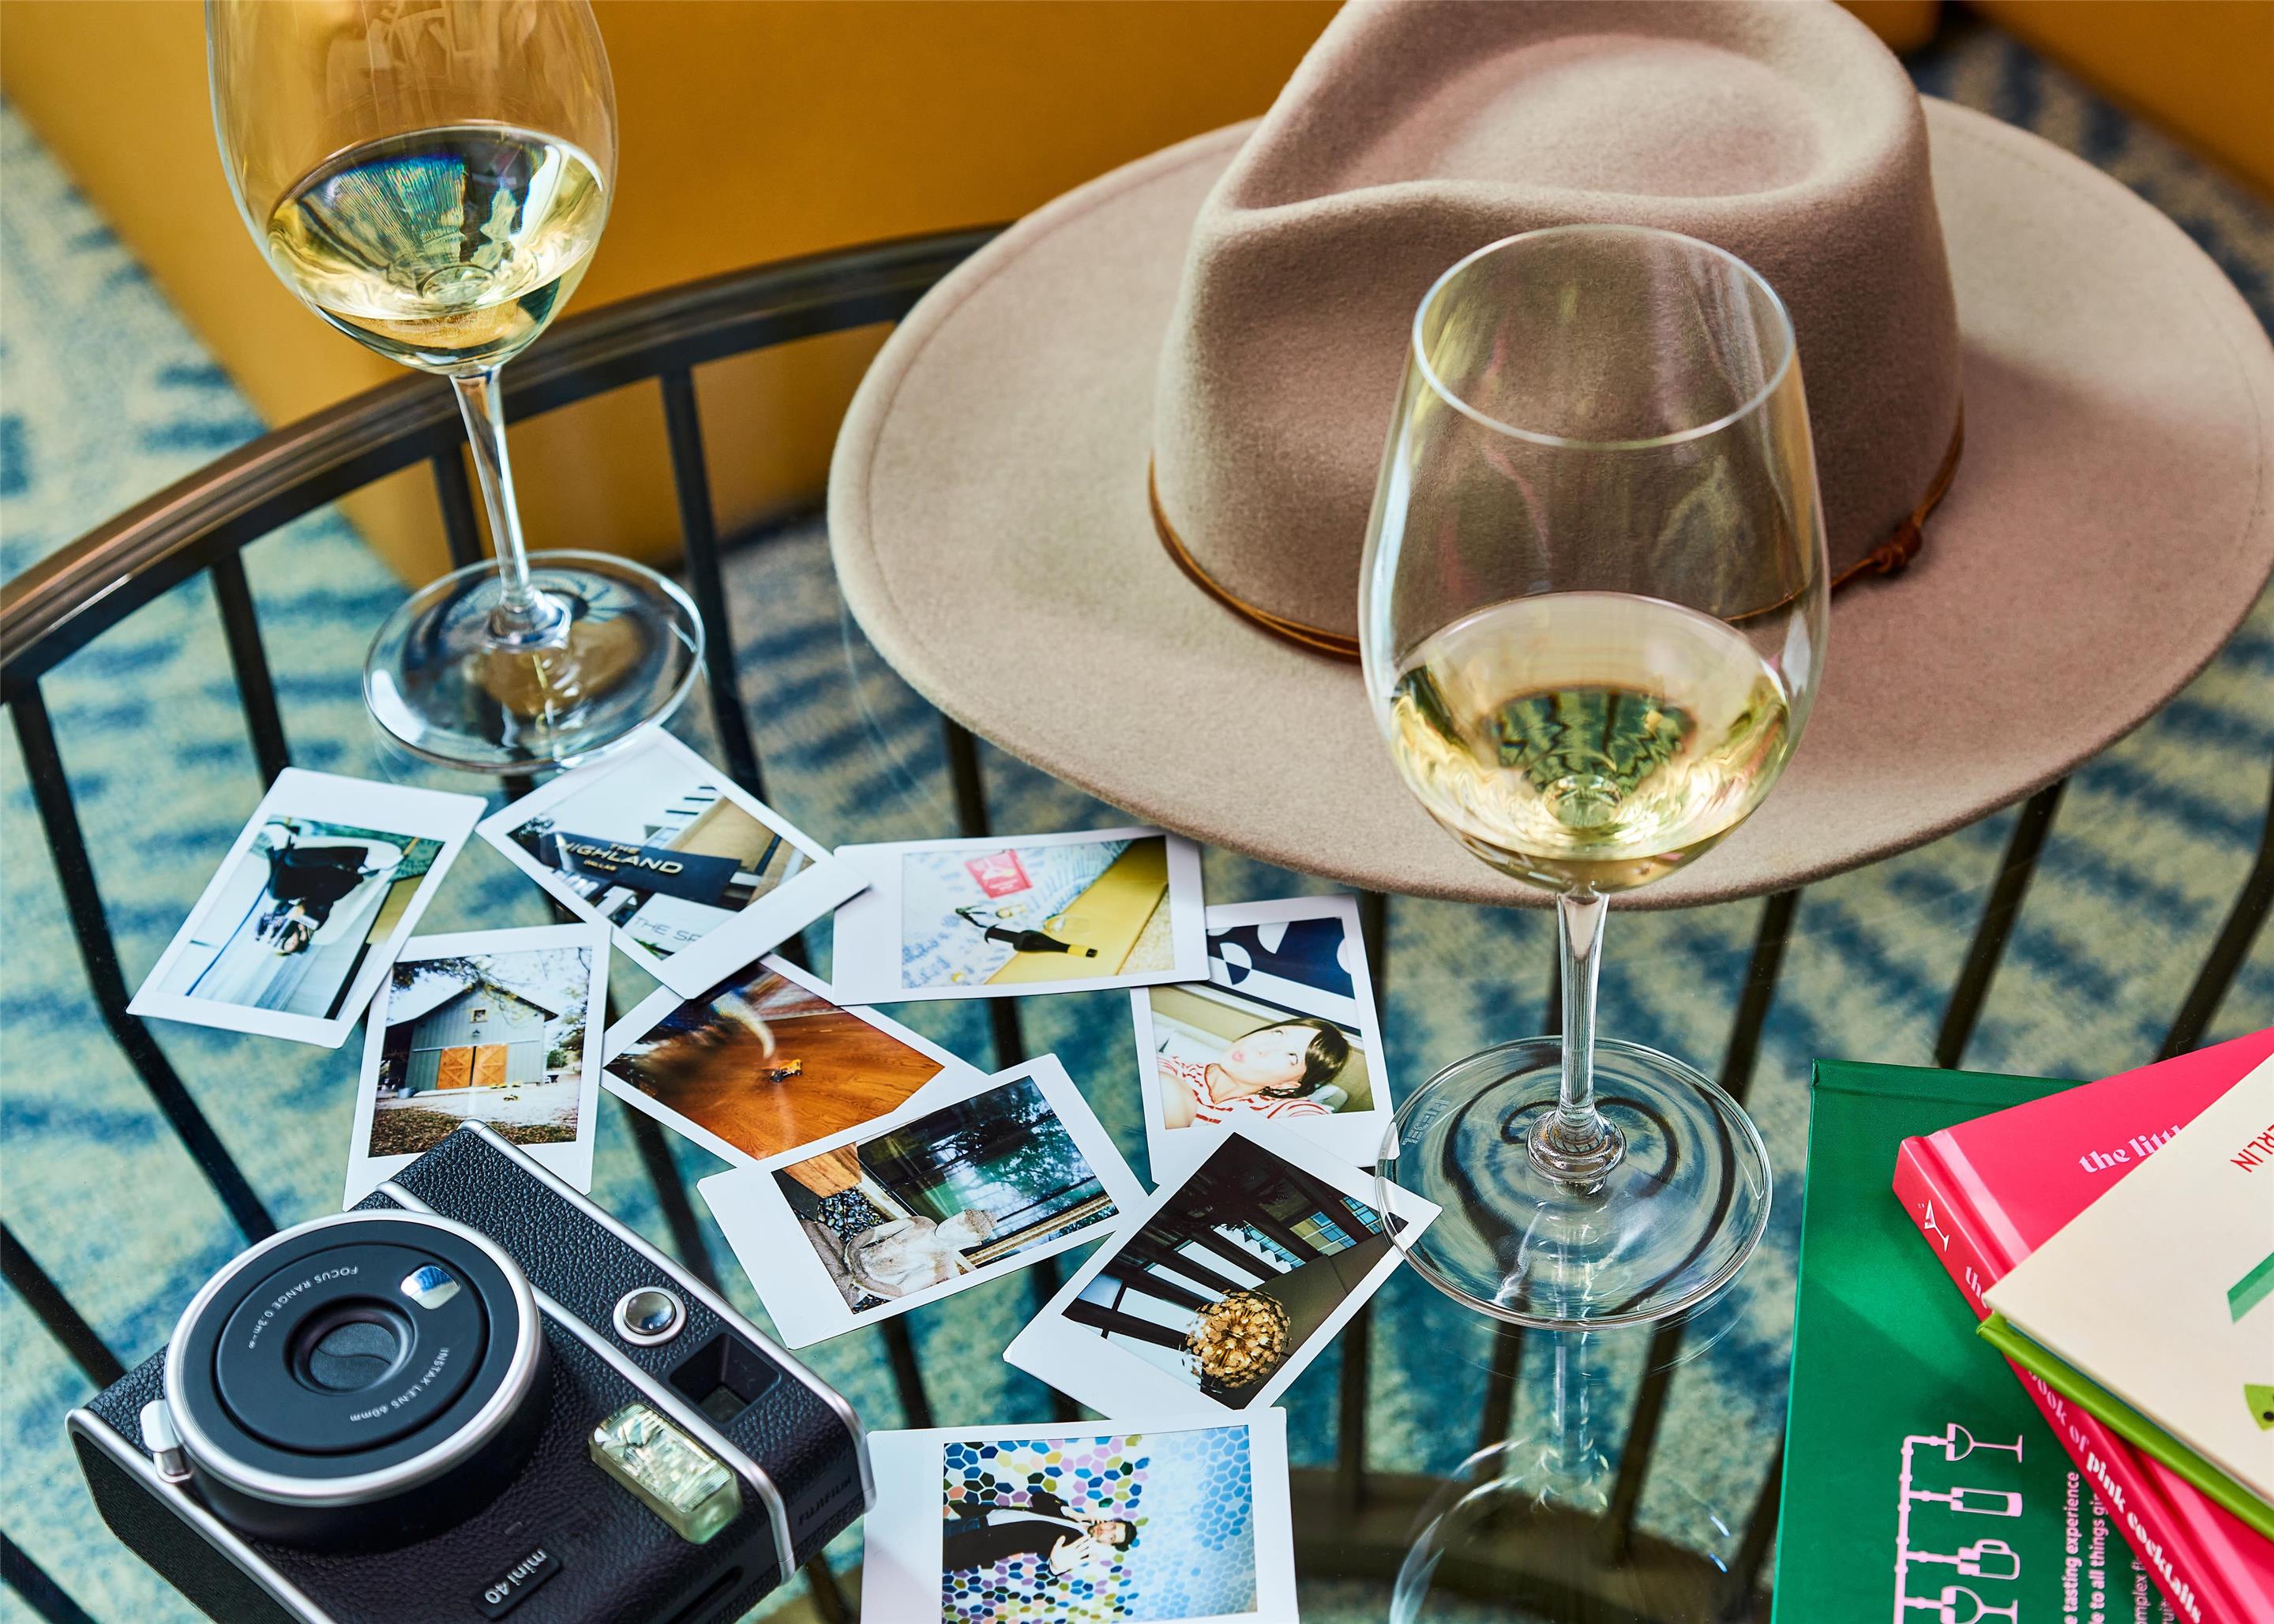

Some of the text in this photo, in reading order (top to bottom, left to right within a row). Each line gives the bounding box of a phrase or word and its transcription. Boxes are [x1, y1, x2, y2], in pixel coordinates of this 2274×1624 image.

[2079, 1149, 2130, 1173] the
[271, 1279, 312, 1311] RANGE
[313, 1266, 359, 1285] FOCUS
[350, 1347, 450, 1422] INSTAX LENS 60mm
[2028, 1371, 2067, 1427] ook
[2069, 1425, 2090, 1453] of
[2086, 1451, 2126, 1514] pink
[2126, 1511, 2201, 1624] cocktails
[2062, 1471, 2083, 1555] experience
[2088, 1518, 2109, 1567] things
[484, 1548, 547, 1604] mini 40
[2061, 1556, 2083, 1613] tasting
[2088, 1569, 2106, 1590] all
[2088, 1591, 2106, 1610] to
